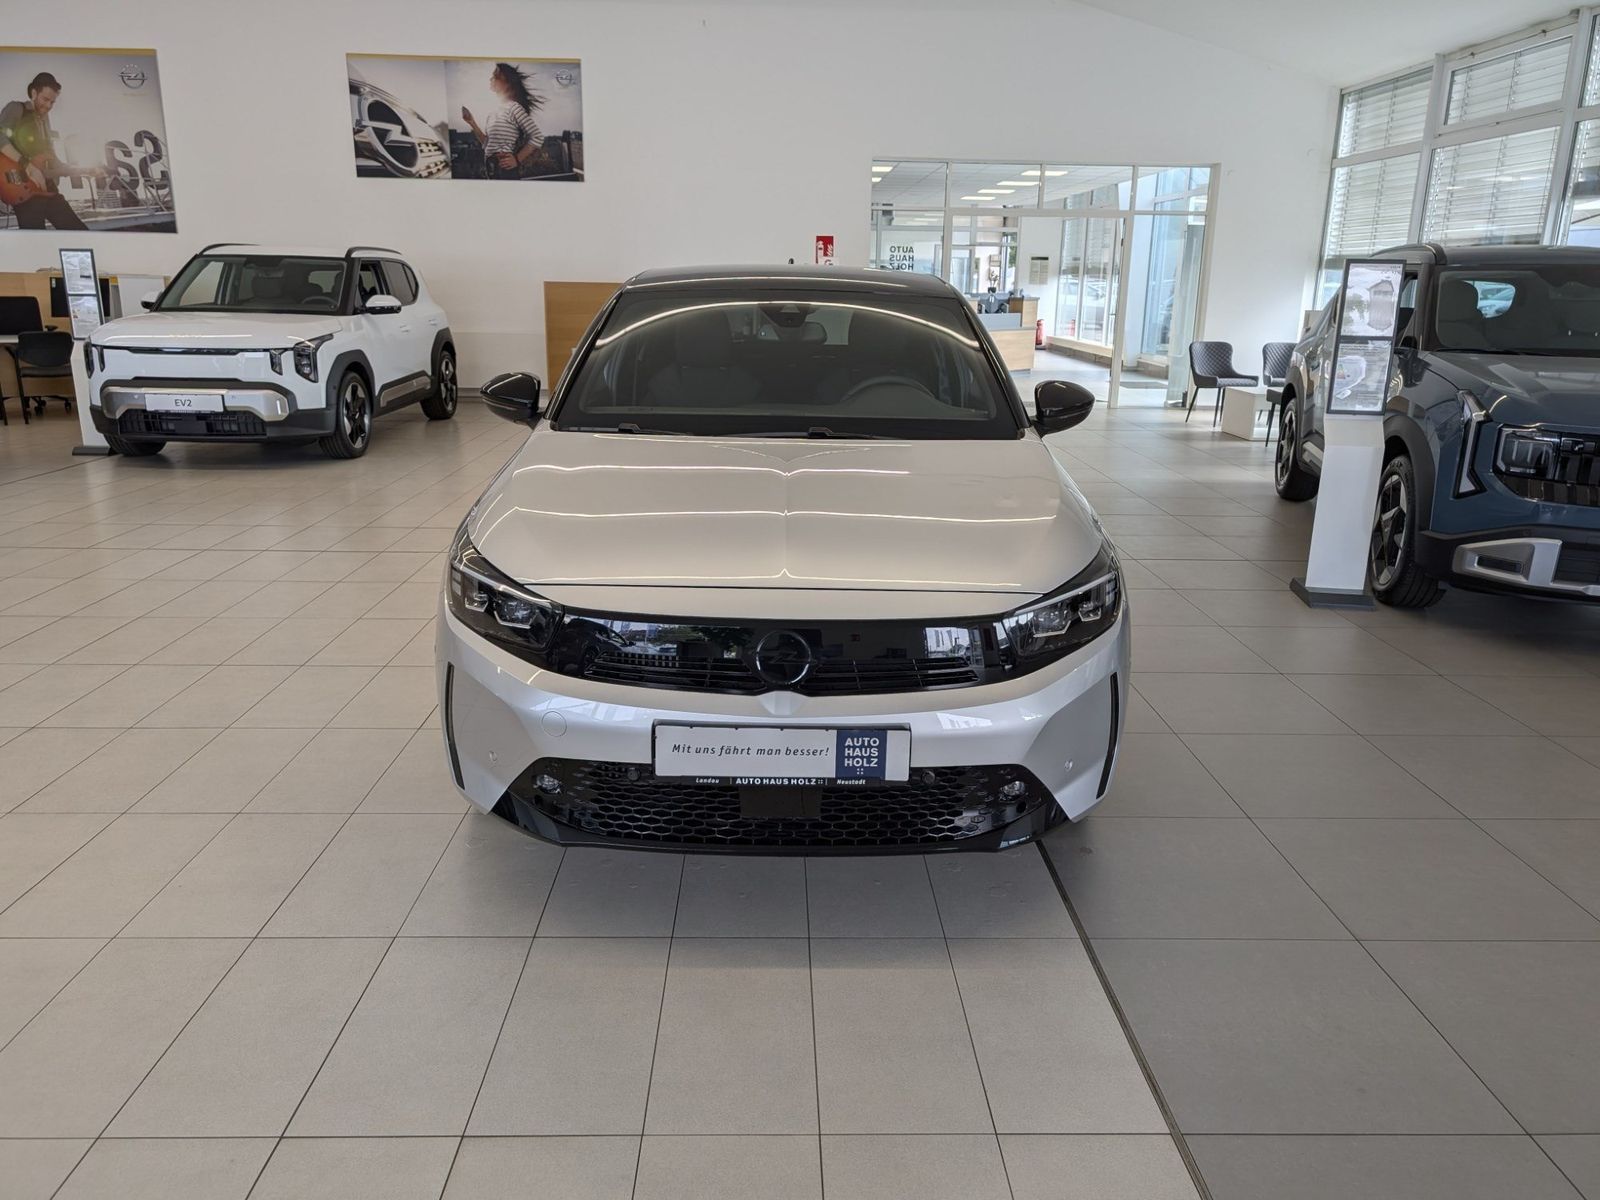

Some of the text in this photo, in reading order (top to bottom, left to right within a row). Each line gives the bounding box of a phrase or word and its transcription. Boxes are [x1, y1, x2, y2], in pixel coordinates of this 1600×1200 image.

[174, 399, 192, 407] EV2
[844, 737, 880, 747] AUTO
[672, 743, 830, 757] Mit uns fährt man besser!
[844, 747, 879, 757] HAUS
[844, 757, 878, 767] HOLZ
[735, 777, 761, 785] AUTO
[762, 777, 789, 785] HAUS
